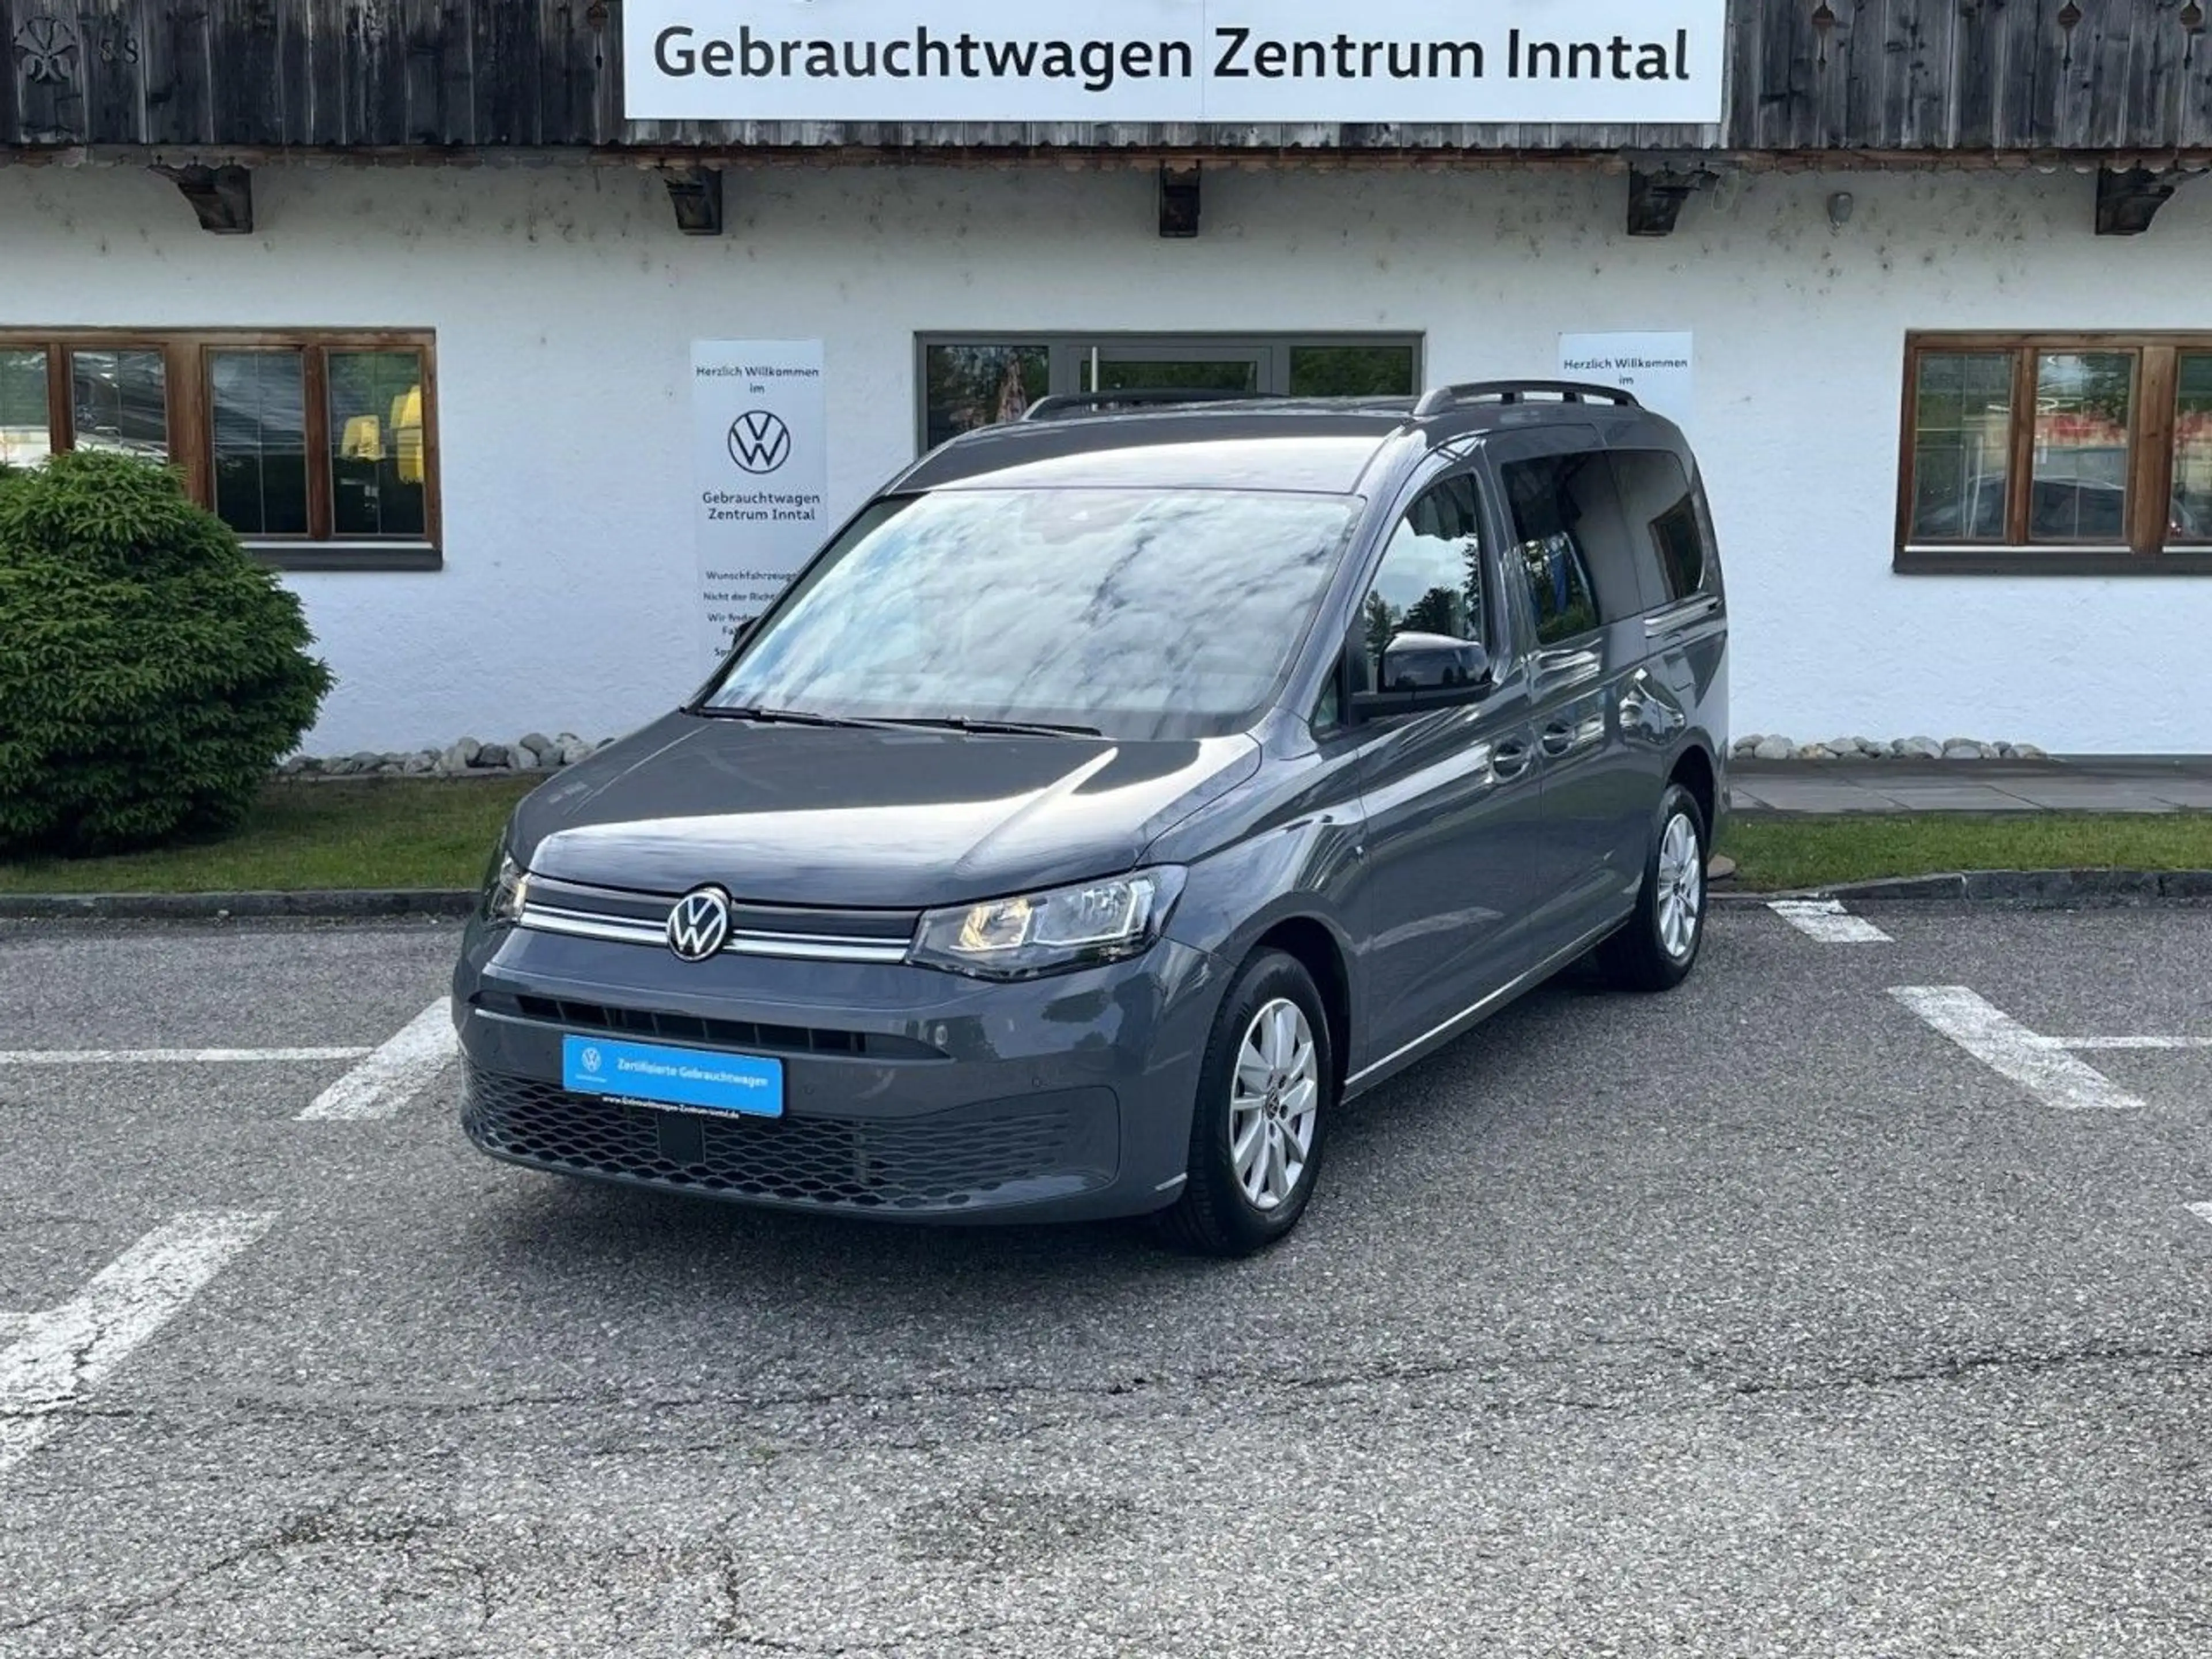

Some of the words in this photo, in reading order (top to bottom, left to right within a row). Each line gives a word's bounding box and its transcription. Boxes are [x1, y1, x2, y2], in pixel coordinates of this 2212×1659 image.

[654, 25, 1192, 93] Gebrauchtwagen
[1213, 27, 1484, 79] Zentrum
[1507, 28, 1690, 81] Inntal
[1563, 358, 1612, 370] Herzlich
[1615, 358, 1688, 369] Willkommen
[696, 366, 743, 377] Herzlich
[745, 366, 819, 377] Willkommen
[1618, 375, 1634, 385] im
[749, 382, 765, 393] im
[728, 410, 790, 474] VW
[702, 491, 820, 507] Gebrauchtwagen
[709, 508, 768, 520] Zentrum
[772, 509, 815, 520] Inntal
[703, 592, 729, 601] Nicht
[730, 592, 748, 601] der
[707, 612, 726, 622] Wir
[667, 892, 726, 961] VW
[616, 1057, 677, 1077] Zertifizierte
[678, 1066, 769, 1088] Gebrauchtwagen
